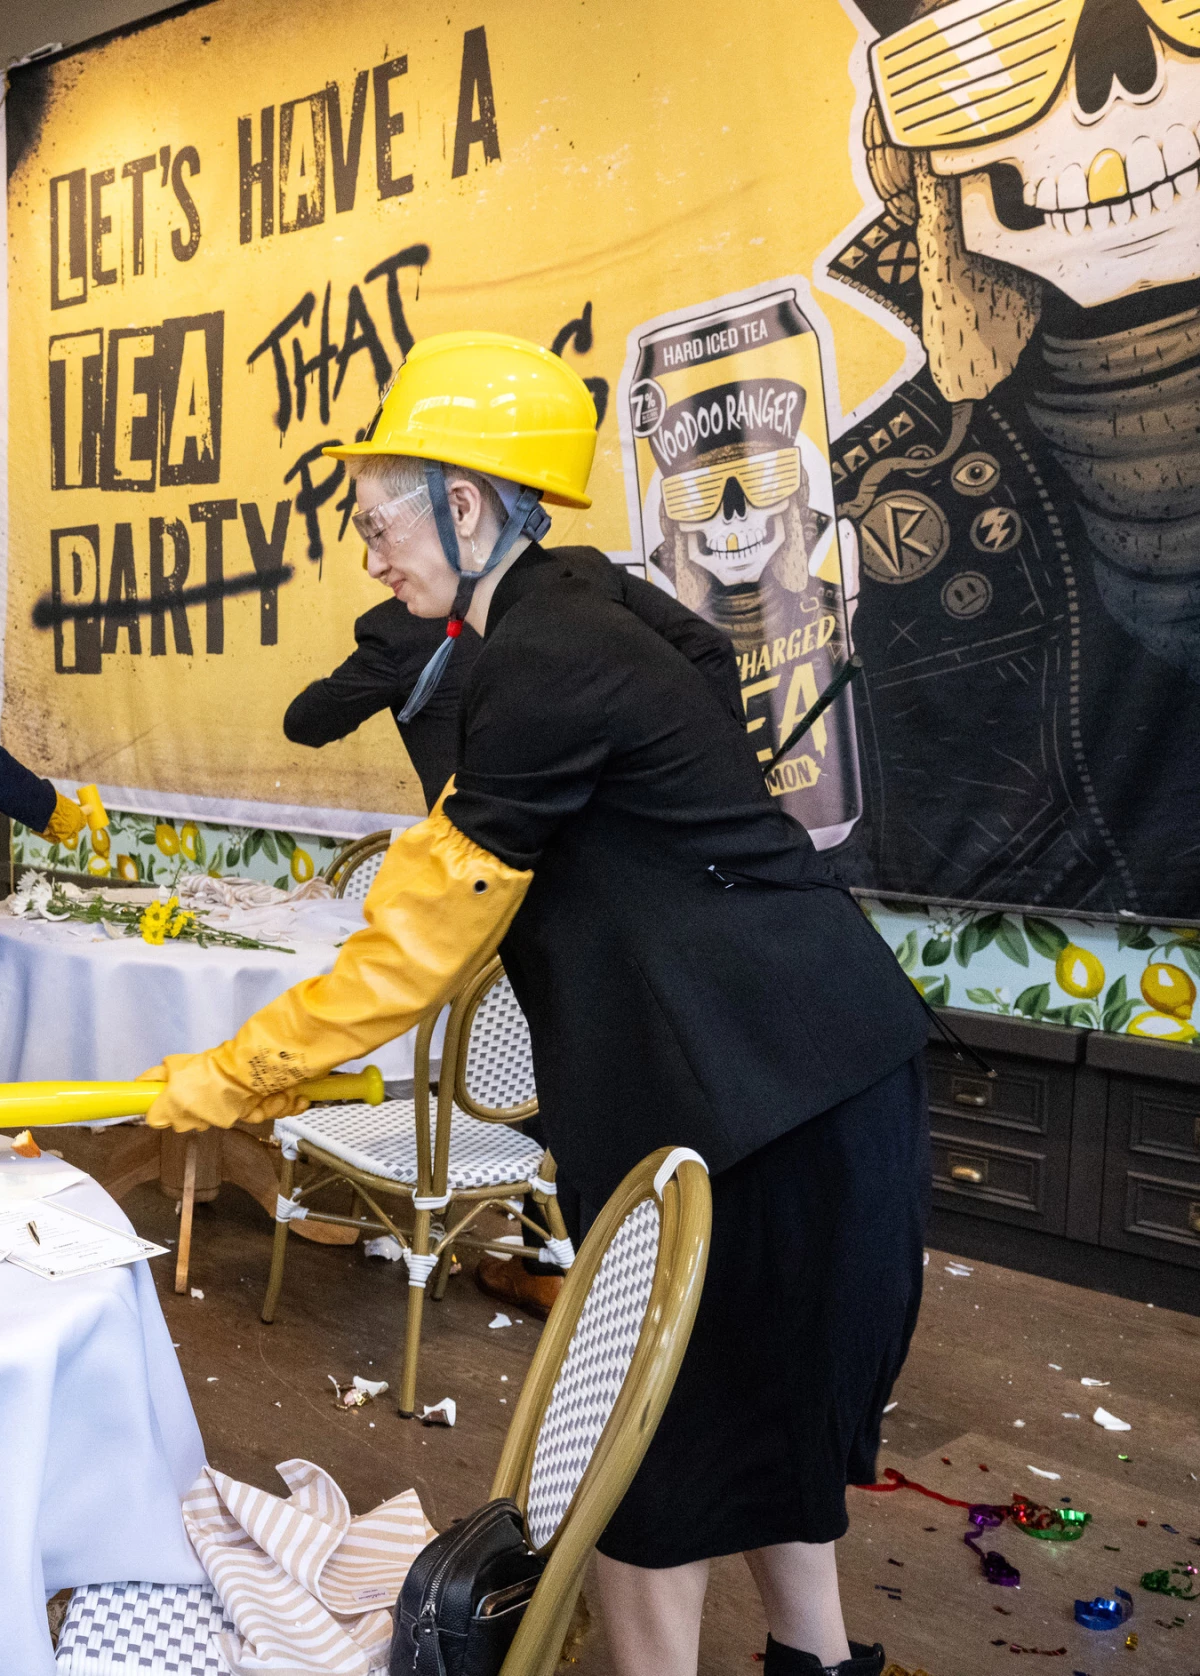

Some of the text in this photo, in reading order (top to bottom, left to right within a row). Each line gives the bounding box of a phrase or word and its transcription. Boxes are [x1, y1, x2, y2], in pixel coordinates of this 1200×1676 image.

[49, 25, 501, 310] LET'S HAVE A
[49, 310, 224, 493] TEA
[247, 244, 430, 433] THAT
[630, 391, 657, 428] 7%
[663, 318, 769, 367] HARD ICED TEA
[652, 387, 799, 467] VOODOO RANGER
[50, 498, 292, 674] PARTY
